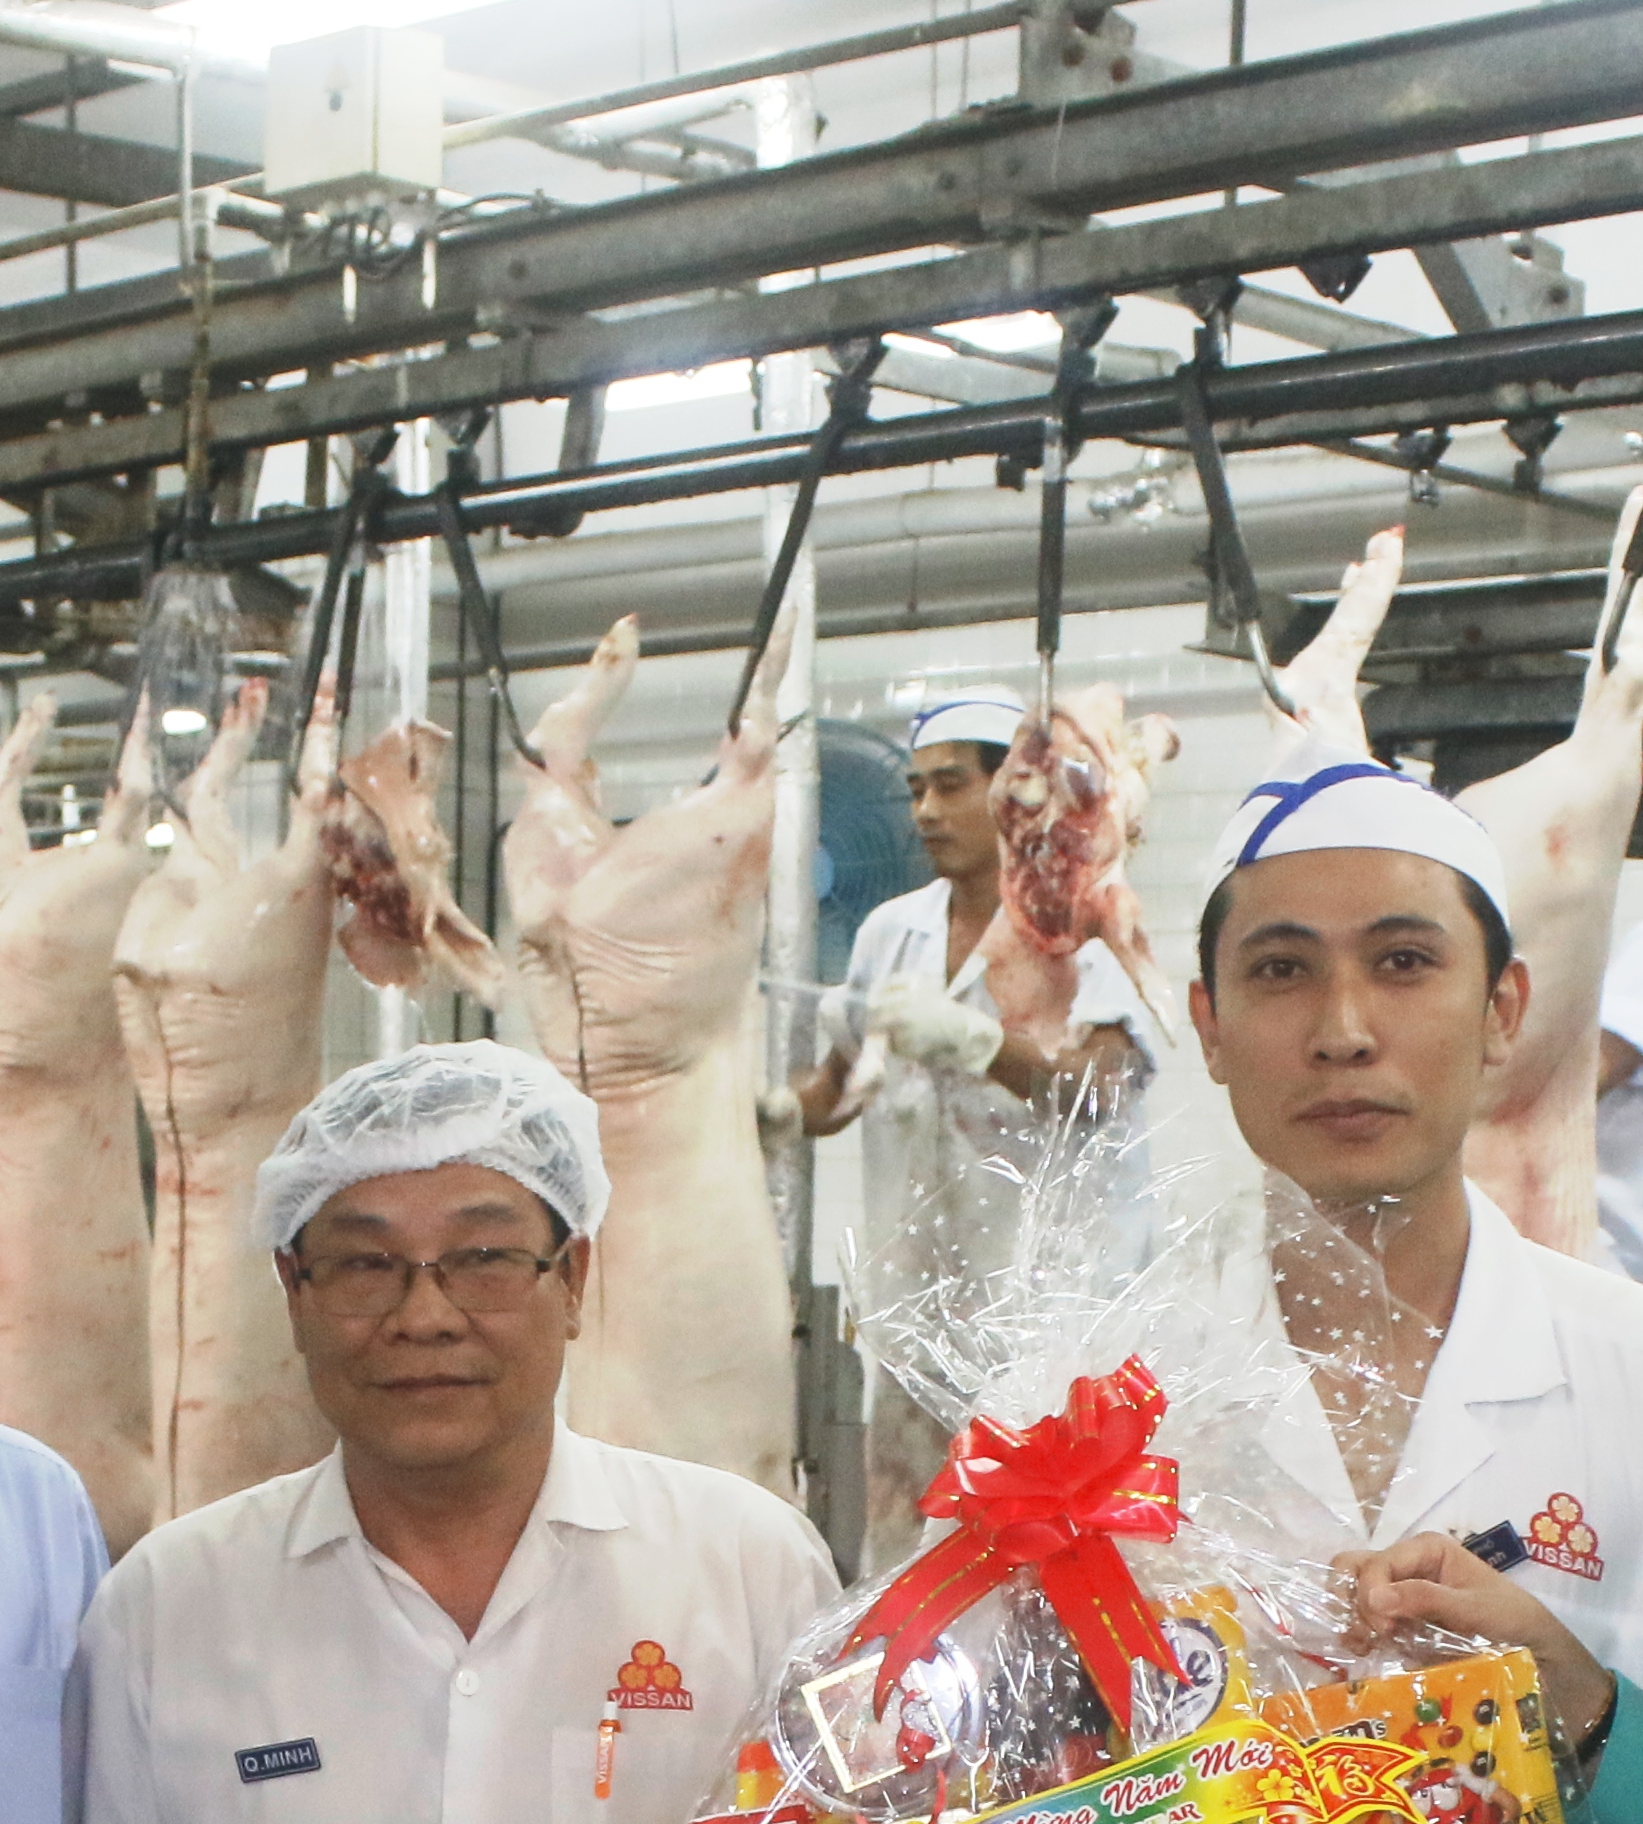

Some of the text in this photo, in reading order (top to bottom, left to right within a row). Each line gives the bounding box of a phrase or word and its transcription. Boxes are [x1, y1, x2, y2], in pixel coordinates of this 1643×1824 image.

[1522, 1540, 1603, 1578] VISSAN
[609, 1691, 692, 1708] VISSAN
[244, 1746, 313, 1773] Q.MINH
[1103, 1771, 1185, 1815] Năm
[1192, 1740, 1273, 1778] Mới
